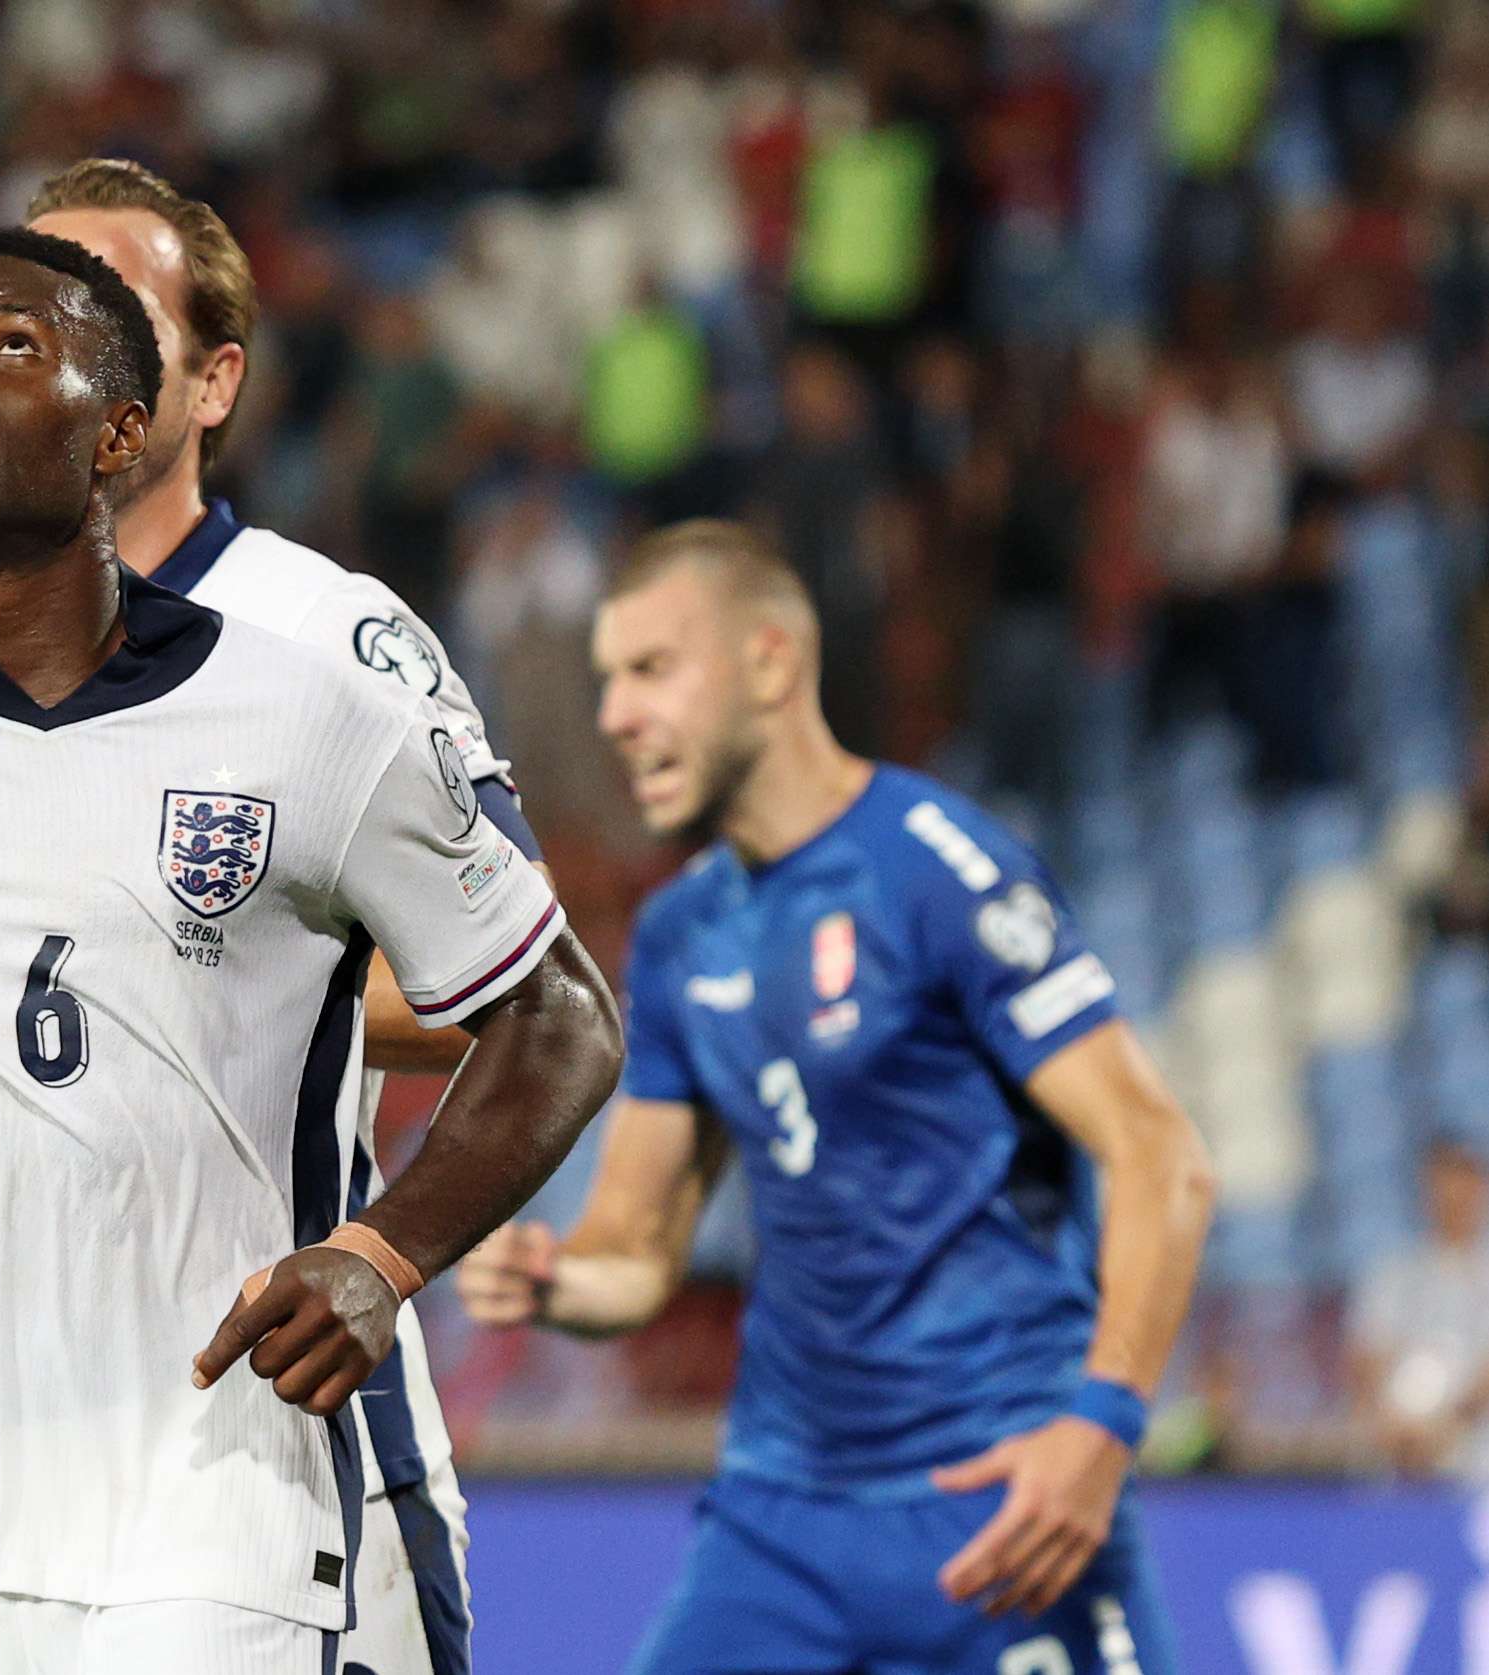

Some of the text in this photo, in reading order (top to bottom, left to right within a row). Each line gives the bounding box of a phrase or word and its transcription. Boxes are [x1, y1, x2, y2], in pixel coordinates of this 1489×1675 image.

[176, 921, 223, 945] SERBIA
[17, 936, 89, 1089] 6
[759, 1058, 817, 1177] 3
